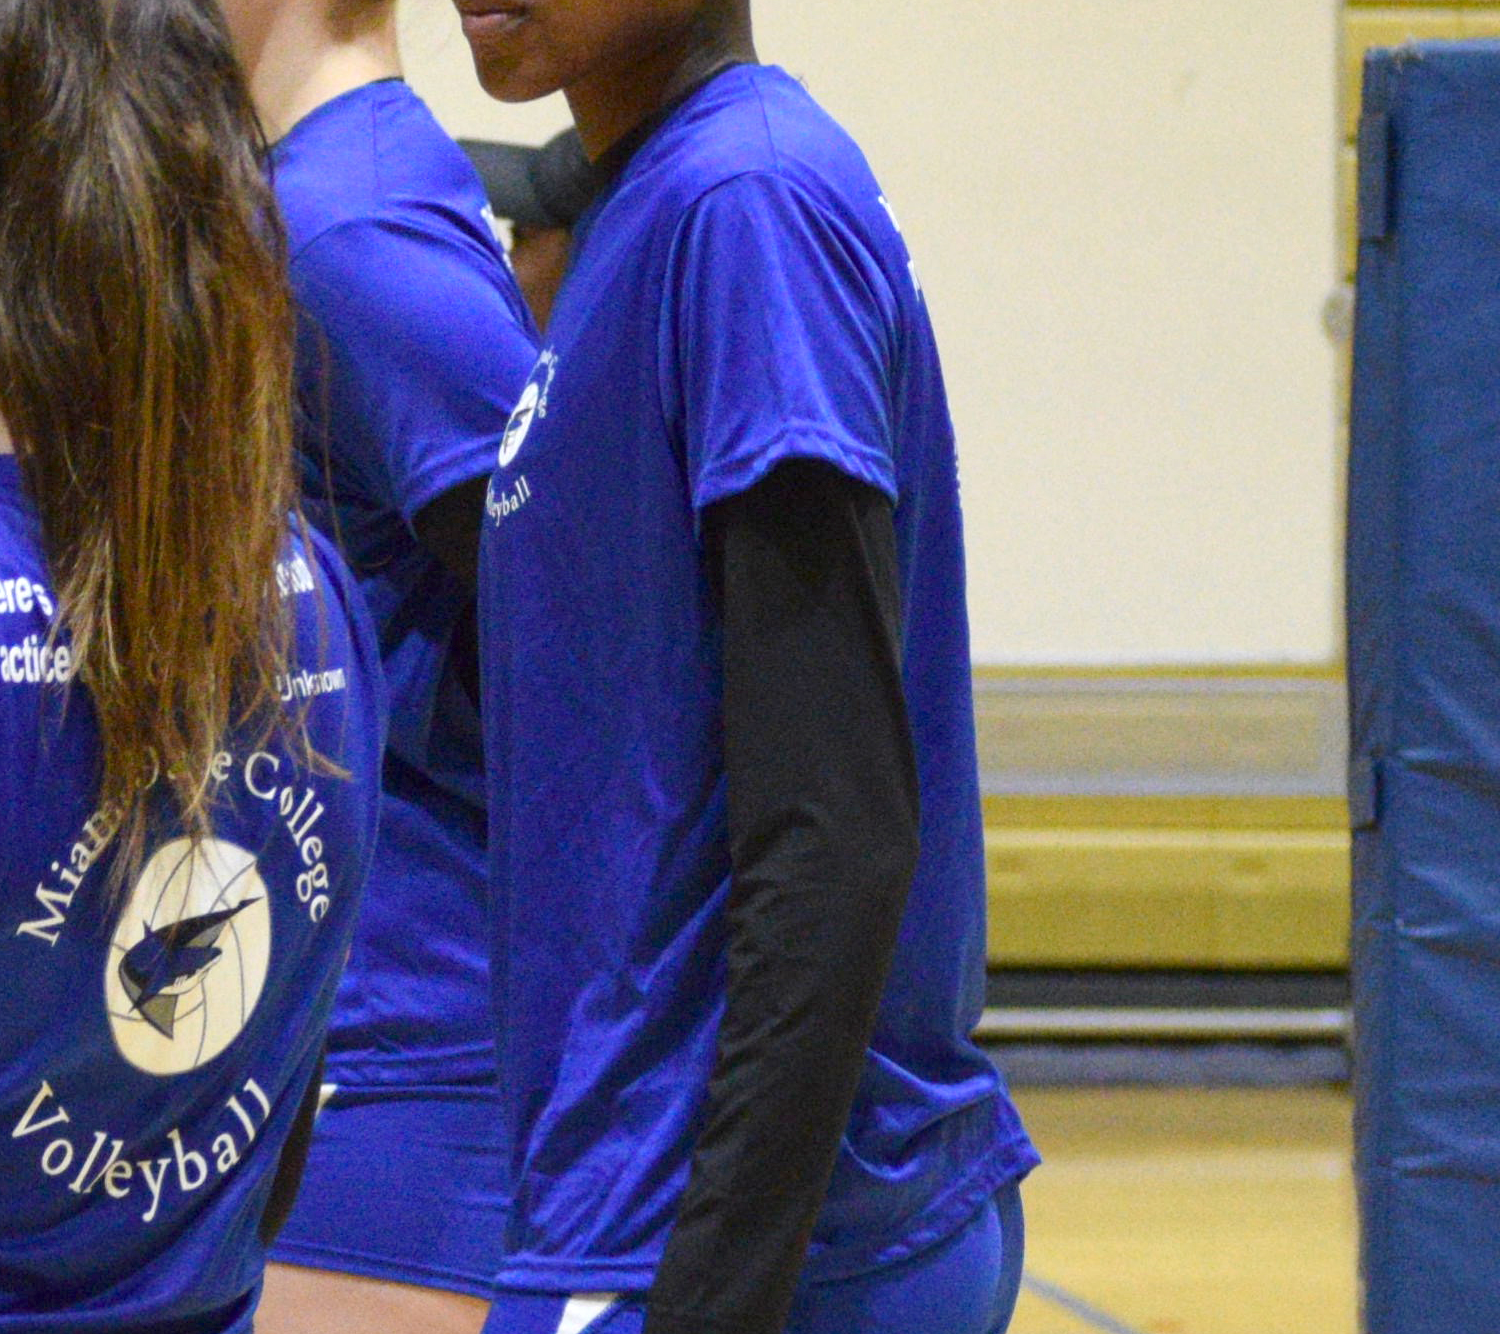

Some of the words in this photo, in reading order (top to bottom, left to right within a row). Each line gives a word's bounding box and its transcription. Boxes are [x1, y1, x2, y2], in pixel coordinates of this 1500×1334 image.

[15, 800, 124, 948] Miam
[244, 750, 331, 924] College
[12, 1079, 271, 1223] Volleyball
